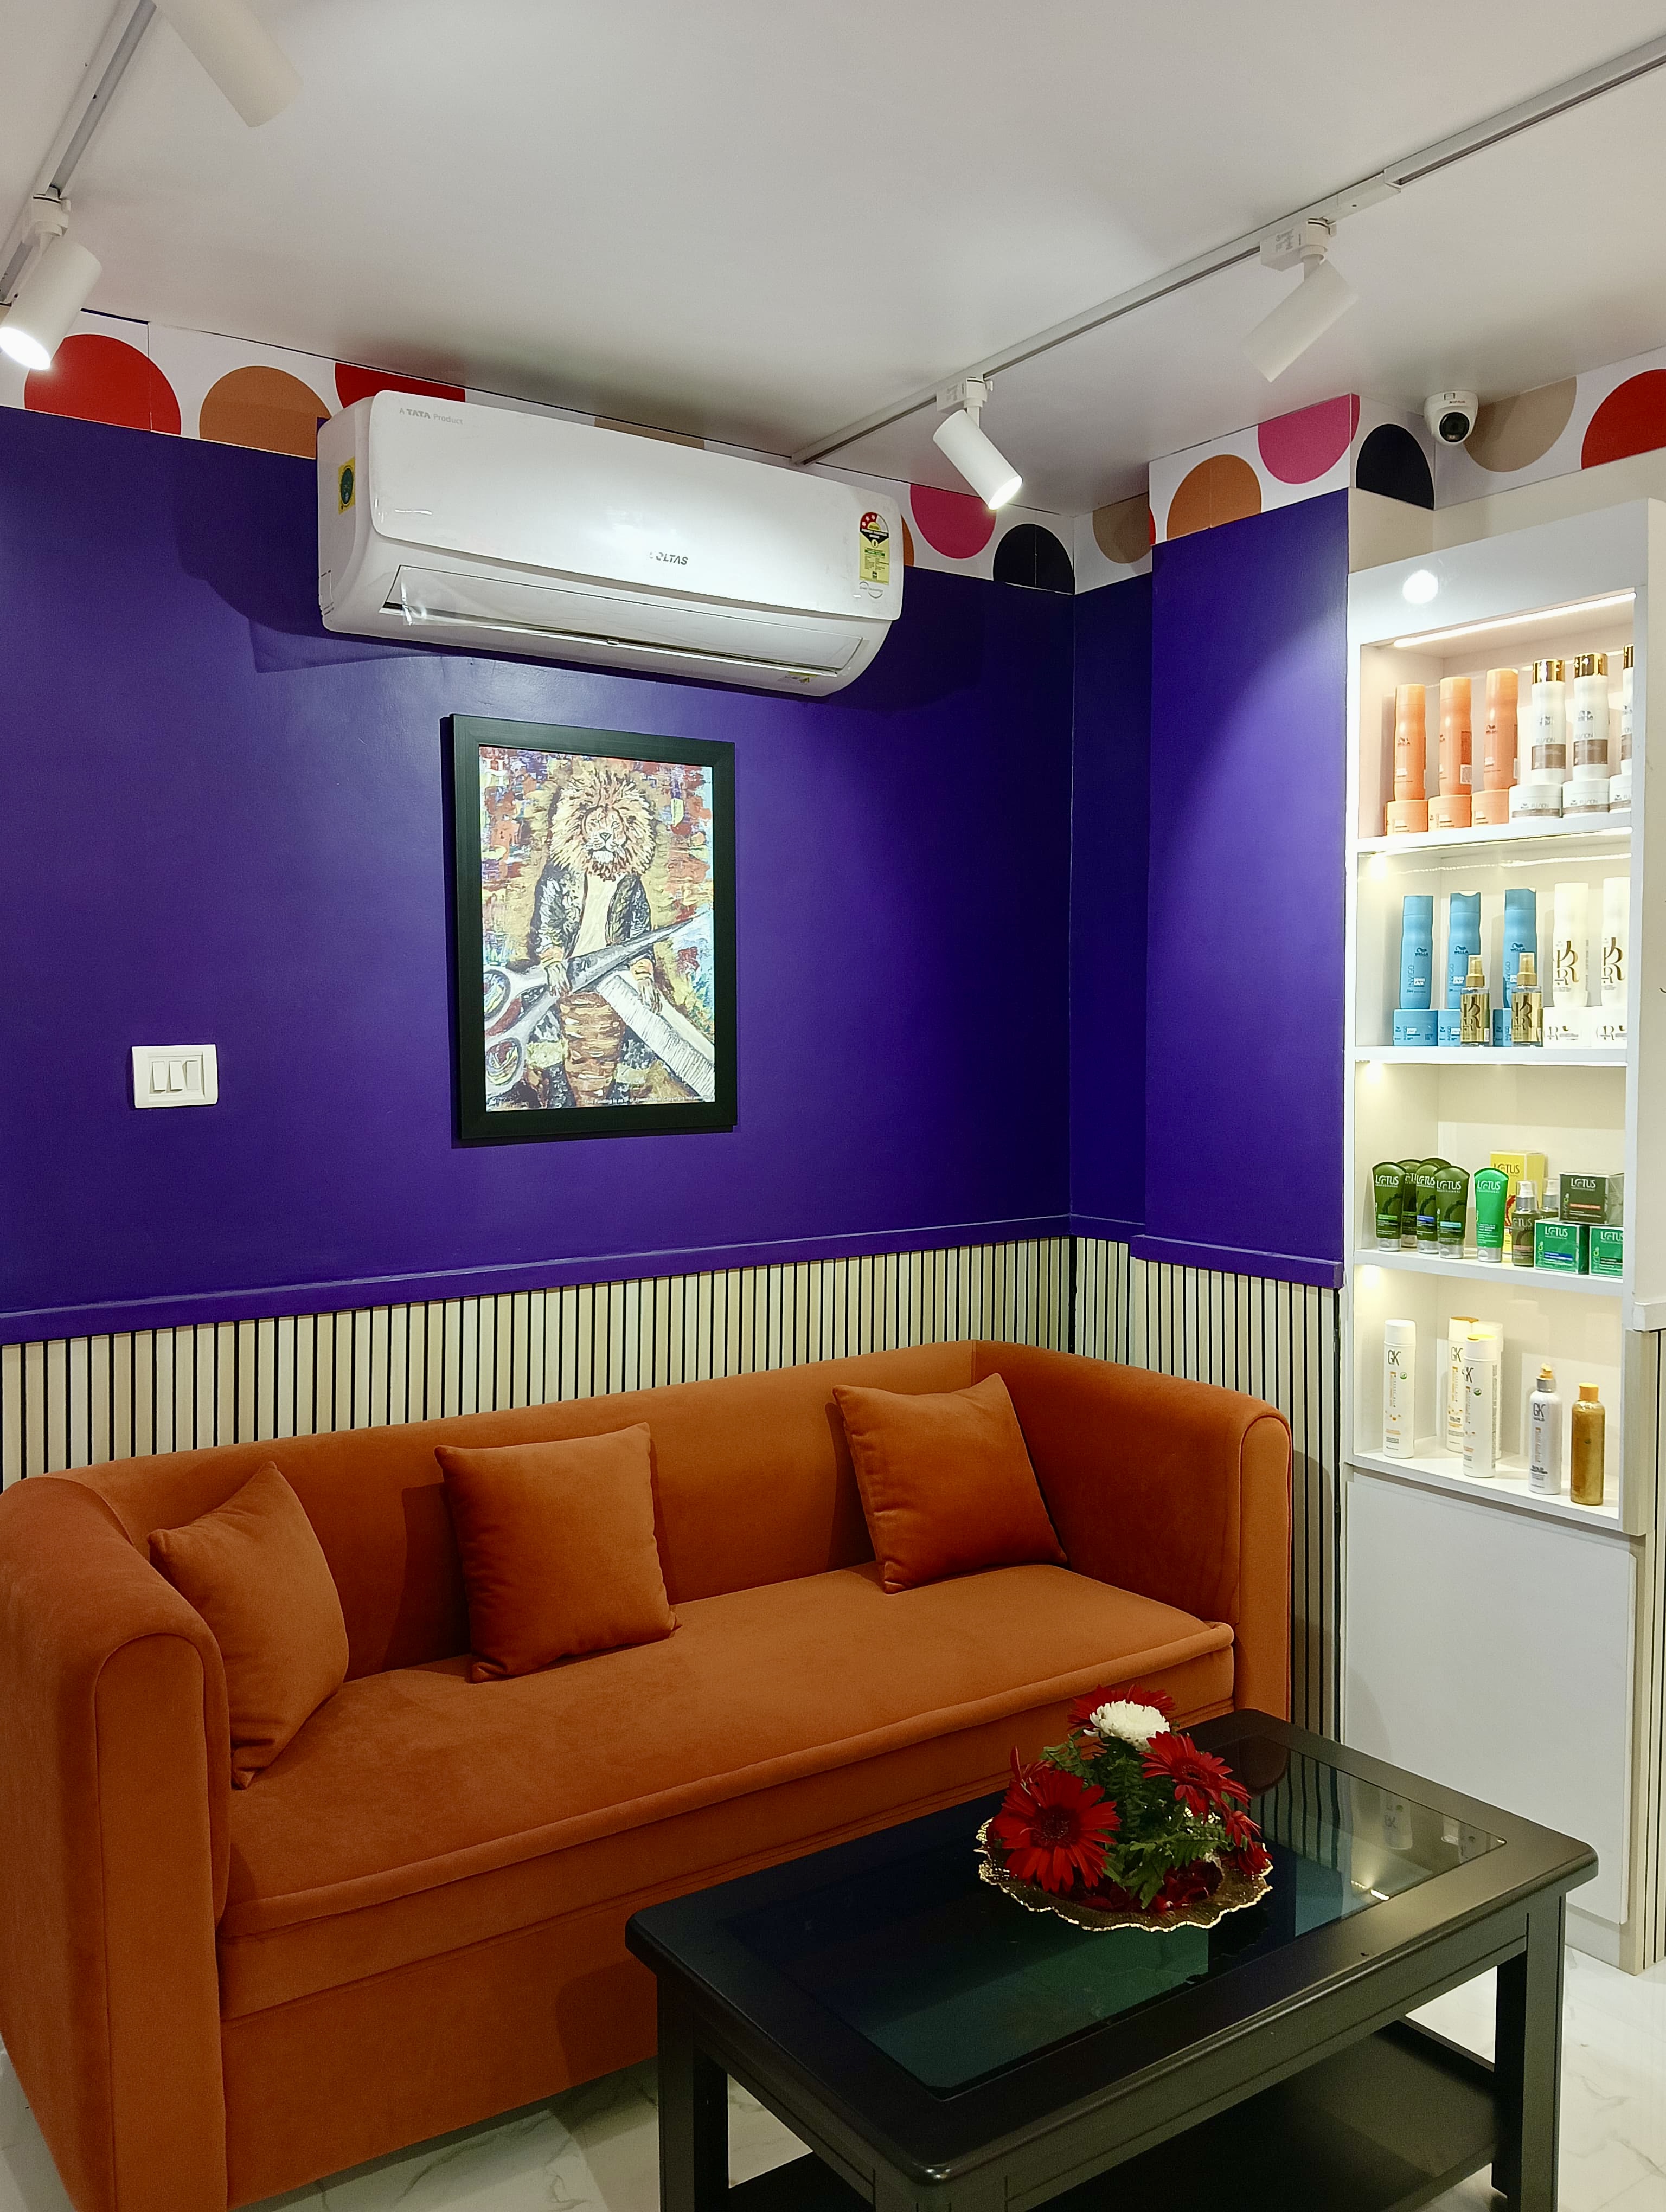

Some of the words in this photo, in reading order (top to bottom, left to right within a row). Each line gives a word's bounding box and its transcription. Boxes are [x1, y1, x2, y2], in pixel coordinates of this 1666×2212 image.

[406, 408, 431, 419] TATA
[433, 413, 463, 425] Product
[649, 551, 688, 565] OLTAS
[1375, 1175, 1399, 1185] LOTUS
[1417, 1175, 1436, 1185] LOTUS
[1437, 1180, 1462, 1190] LOTUS
[1477, 1180, 1501, 1190] LOTUS
[1571, 1178, 1596, 1189] LOTUS
[1545, 1226, 1568, 1237] LOTUS
[1388, 1349, 1401, 1366] GK
[1451, 1346, 1464, 1362] GK
[1533, 1403, 1546, 1418] GK
